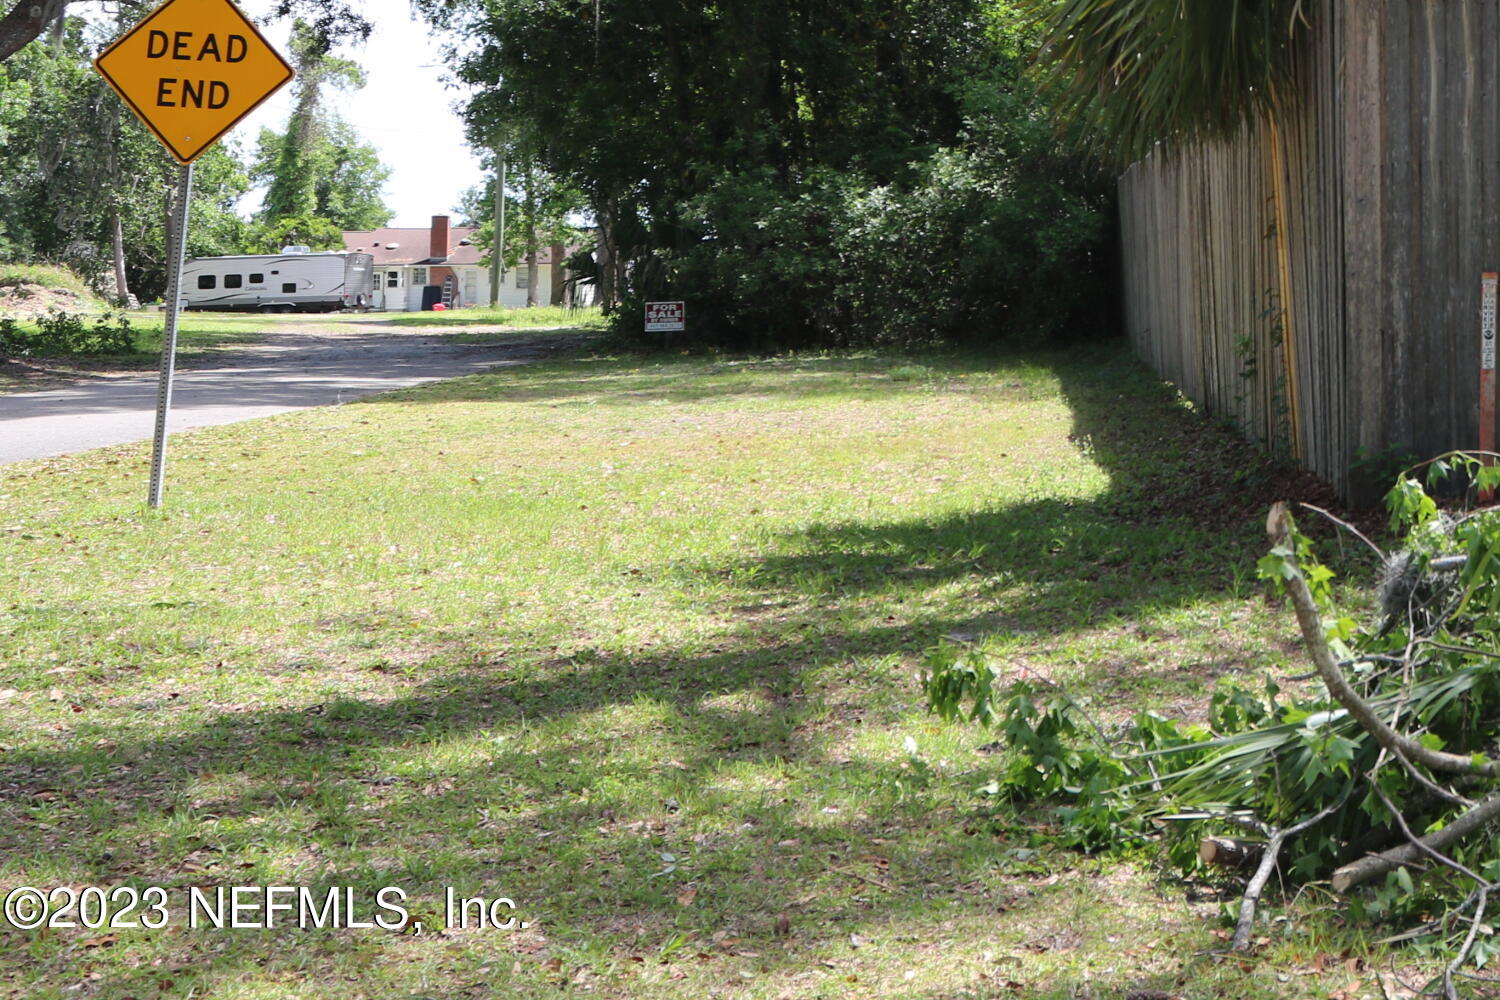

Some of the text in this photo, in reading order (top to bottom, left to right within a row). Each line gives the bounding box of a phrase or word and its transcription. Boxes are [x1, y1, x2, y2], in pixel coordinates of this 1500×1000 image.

[146, 29, 248, 63] DEAD
[156, 77, 231, 110] END
[648, 310, 682, 318] SALE
